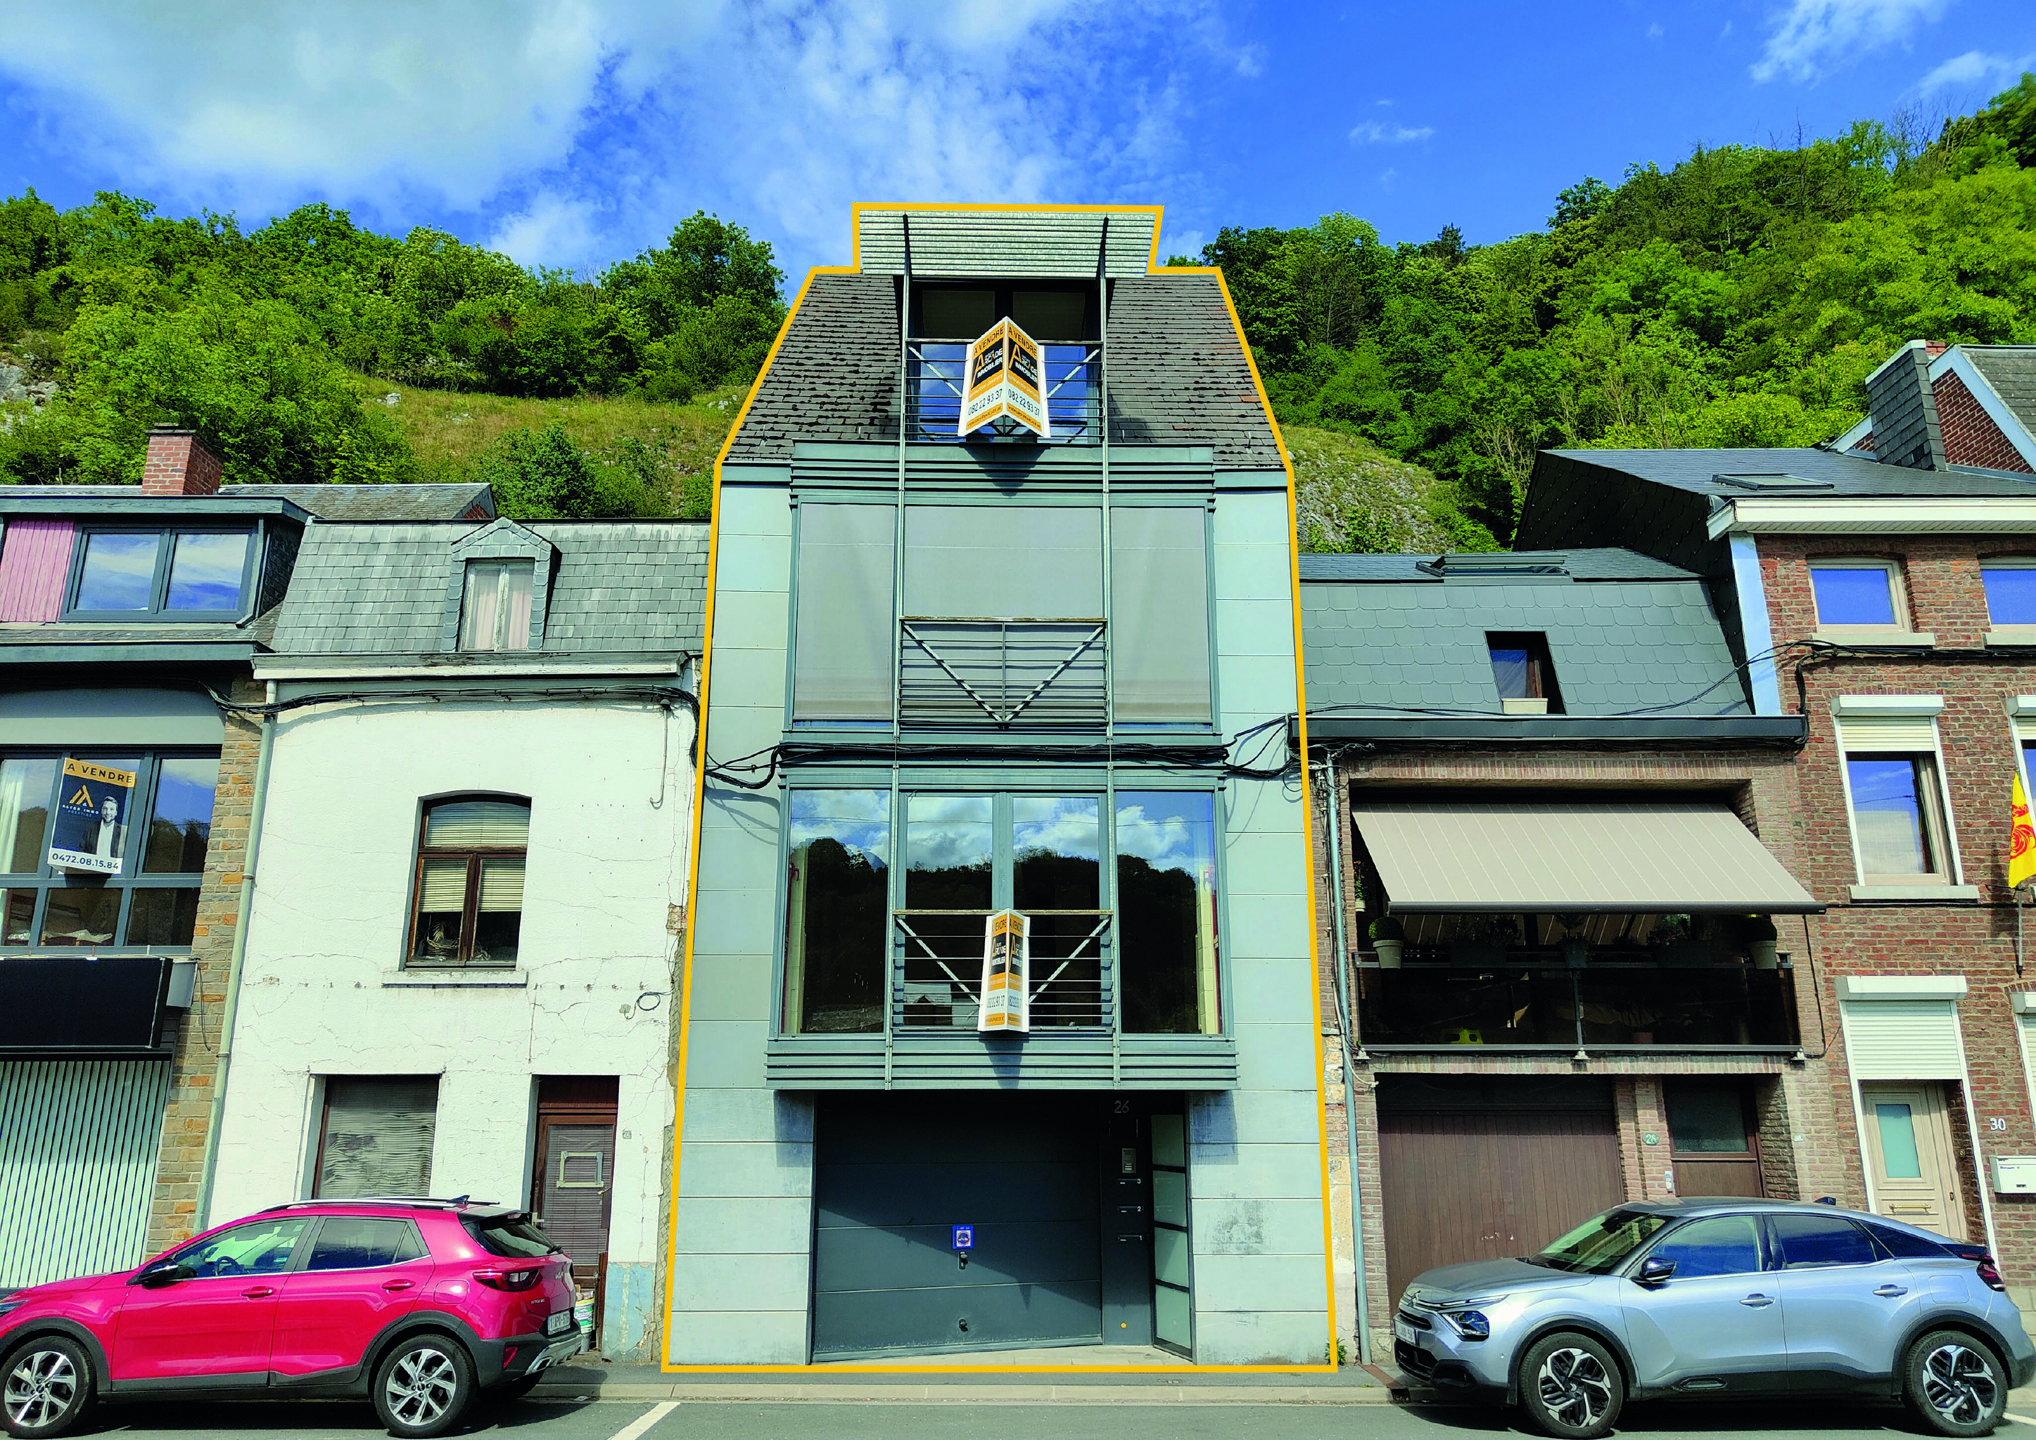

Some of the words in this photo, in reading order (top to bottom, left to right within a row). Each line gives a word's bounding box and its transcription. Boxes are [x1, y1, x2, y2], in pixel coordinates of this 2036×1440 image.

[979, 326, 1004, 351] VENDRE
[1013, 330, 1037, 357] VENDRE
[67, 763, 76, 772] A
[81, 765, 133, 784] VENDRE
[52, 852, 119, 870] 0472.08.15.84
[1113, 1099, 1130, 1114] 26
[1989, 1117, 2006, 1131] 30
